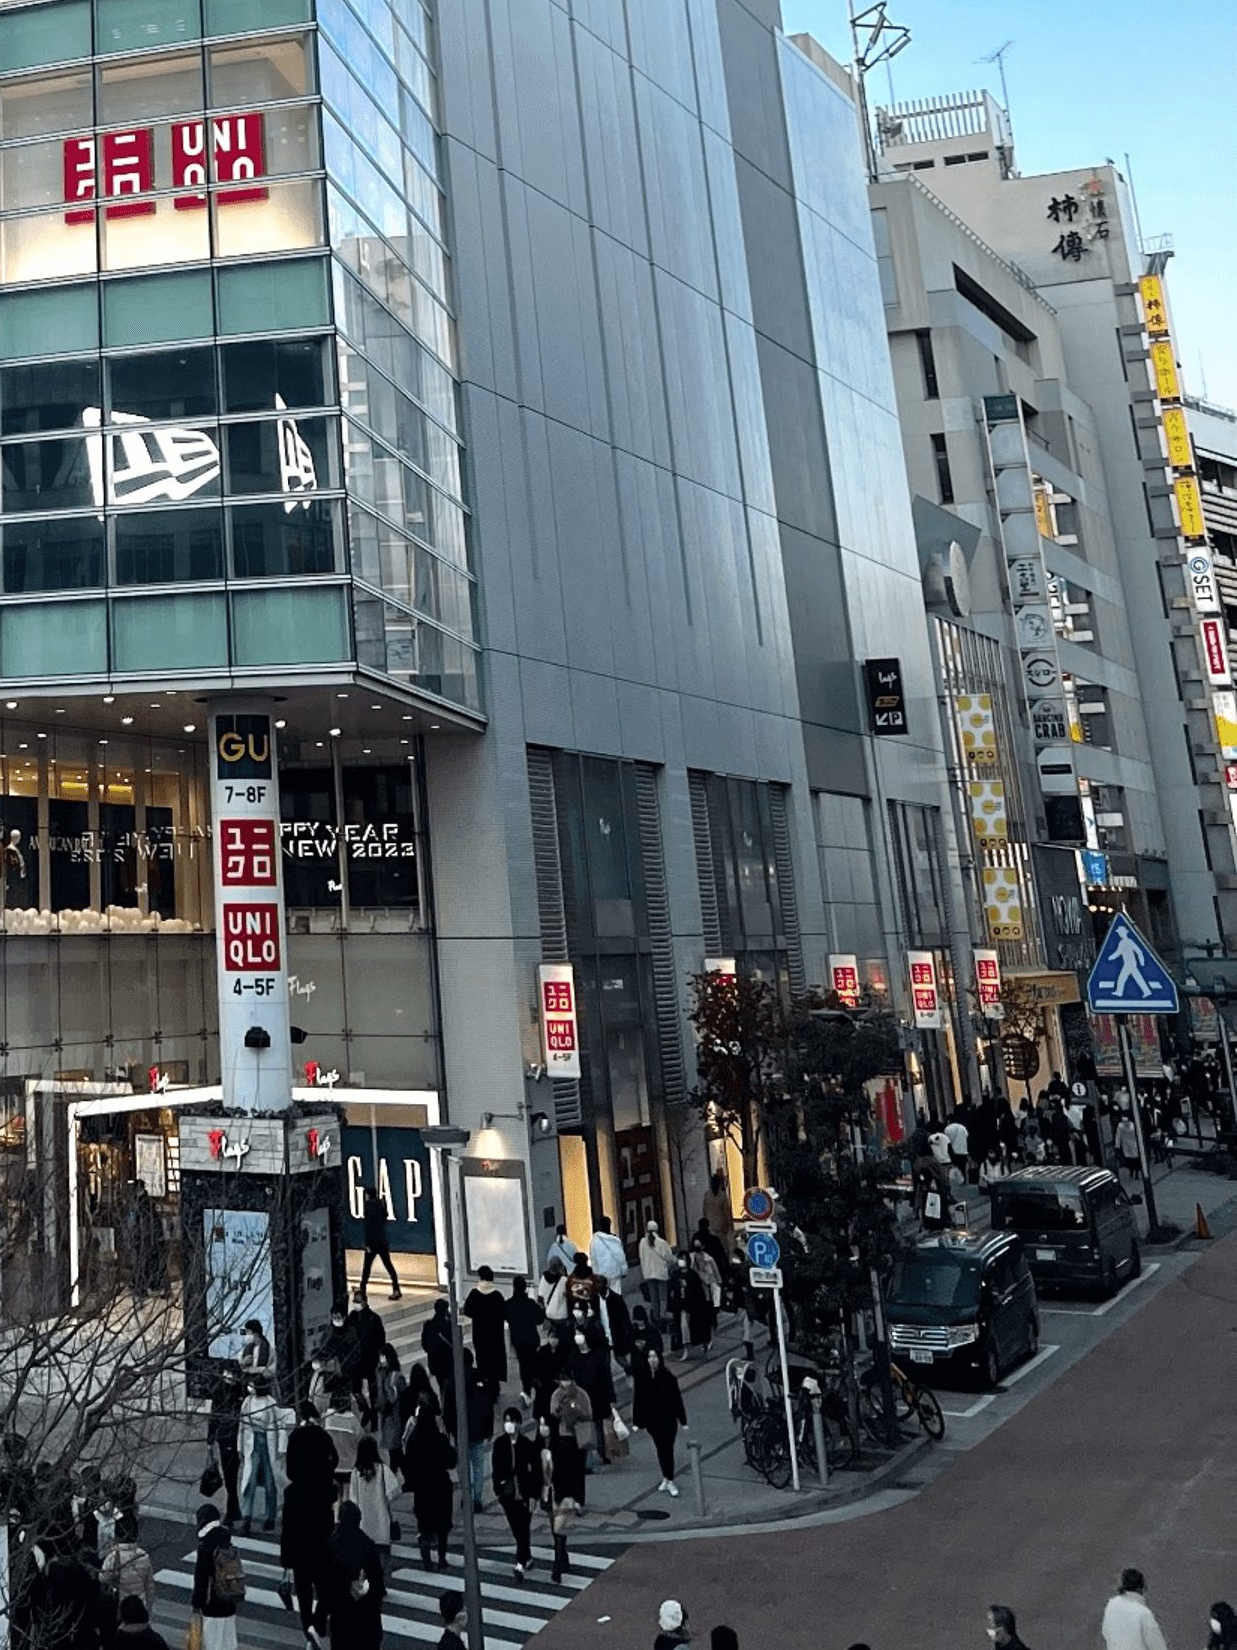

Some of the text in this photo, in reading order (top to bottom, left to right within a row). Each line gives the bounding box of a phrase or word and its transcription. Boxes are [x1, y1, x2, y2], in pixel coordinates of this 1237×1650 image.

[1035, 723, 1066, 739] CRAB
[219, 732, 269, 762] GU
[224, 785, 267, 804] 7-8F
[351, 842, 415, 858] 2023
[228, 911, 271, 936] UNI
[229, 939, 276, 967] QLO
[233, 977, 276, 996] 4-5F
[287, 975, 317, 1003] Flags
[549, 1023, 570, 1035] UNI
[550, 1036, 572, 1048] QLO
[303, 1060, 340, 1092] Flags
[207, 1127, 250, 1170] Flags
[347, 1155, 422, 1223] GAP
